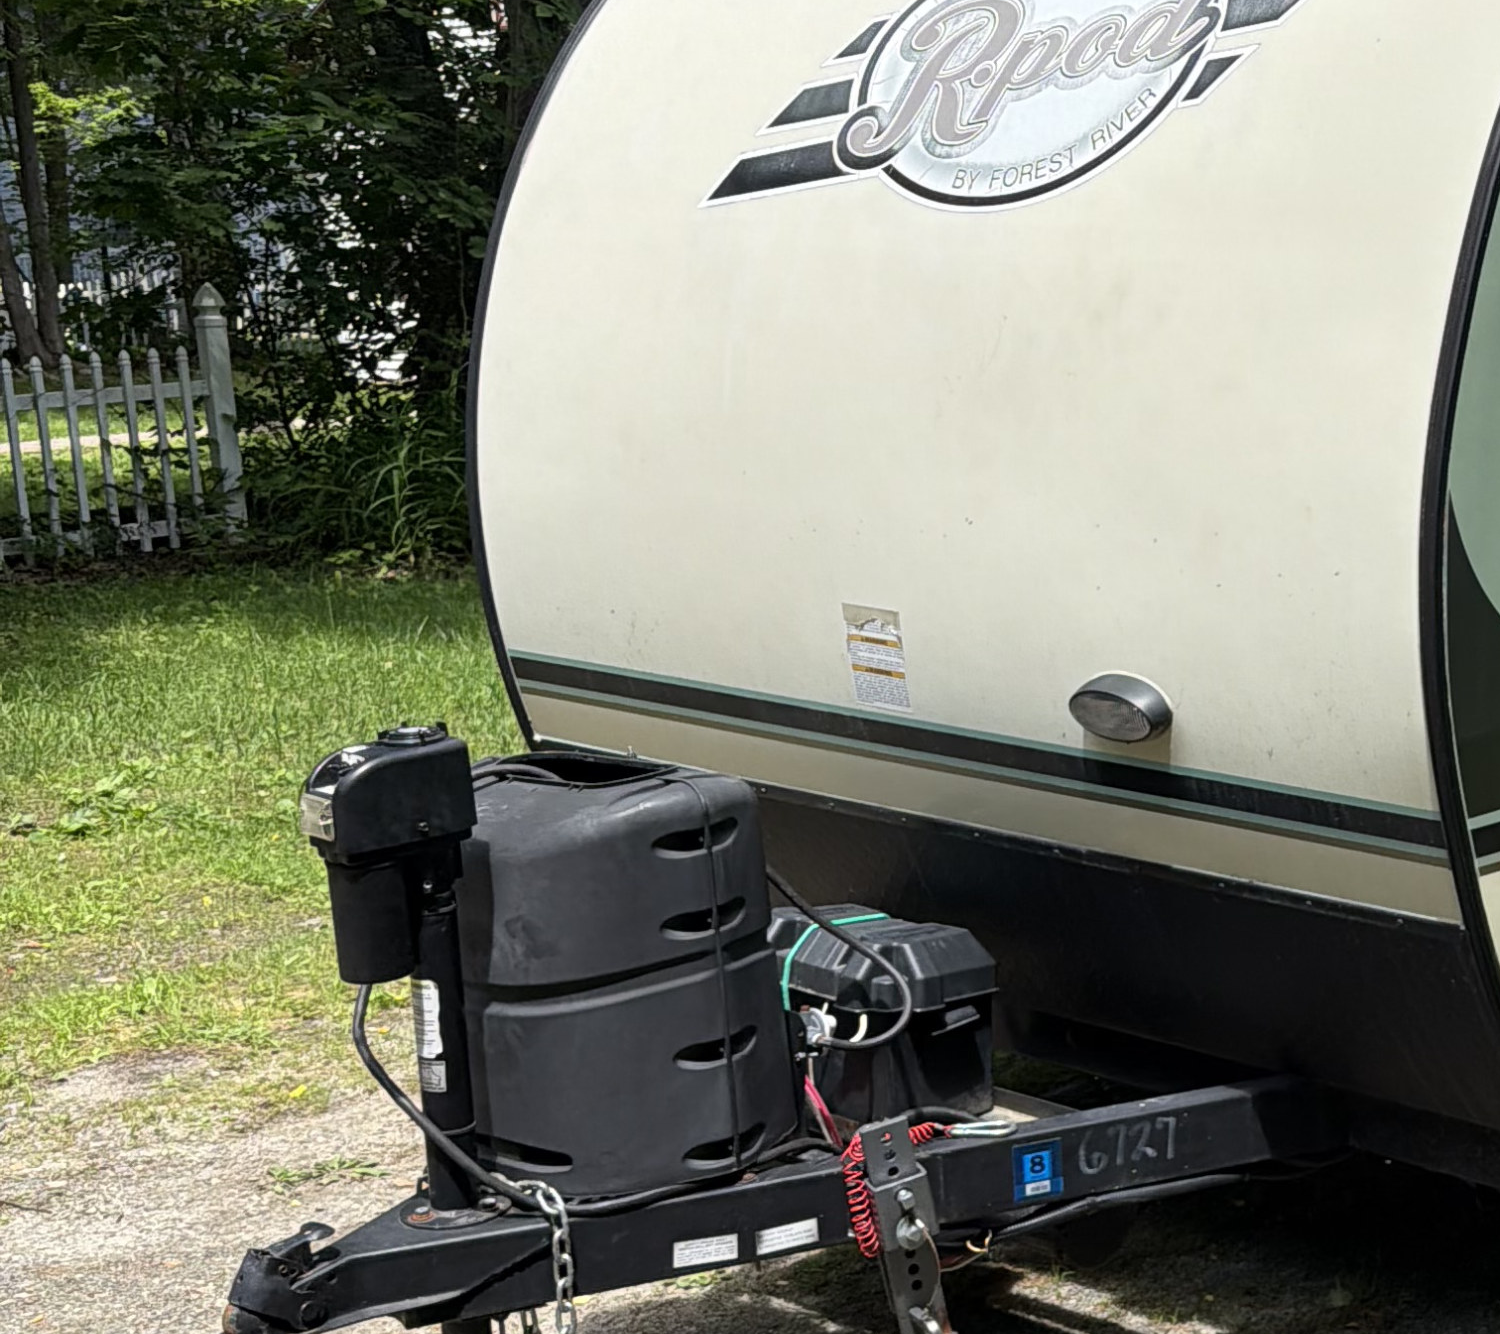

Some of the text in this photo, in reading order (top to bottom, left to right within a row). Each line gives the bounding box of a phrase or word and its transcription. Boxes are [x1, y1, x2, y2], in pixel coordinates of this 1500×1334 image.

[951, 87, 1158, 191] BY FOREST RIVER
[1029, 1154, 1046, 1174] 8
